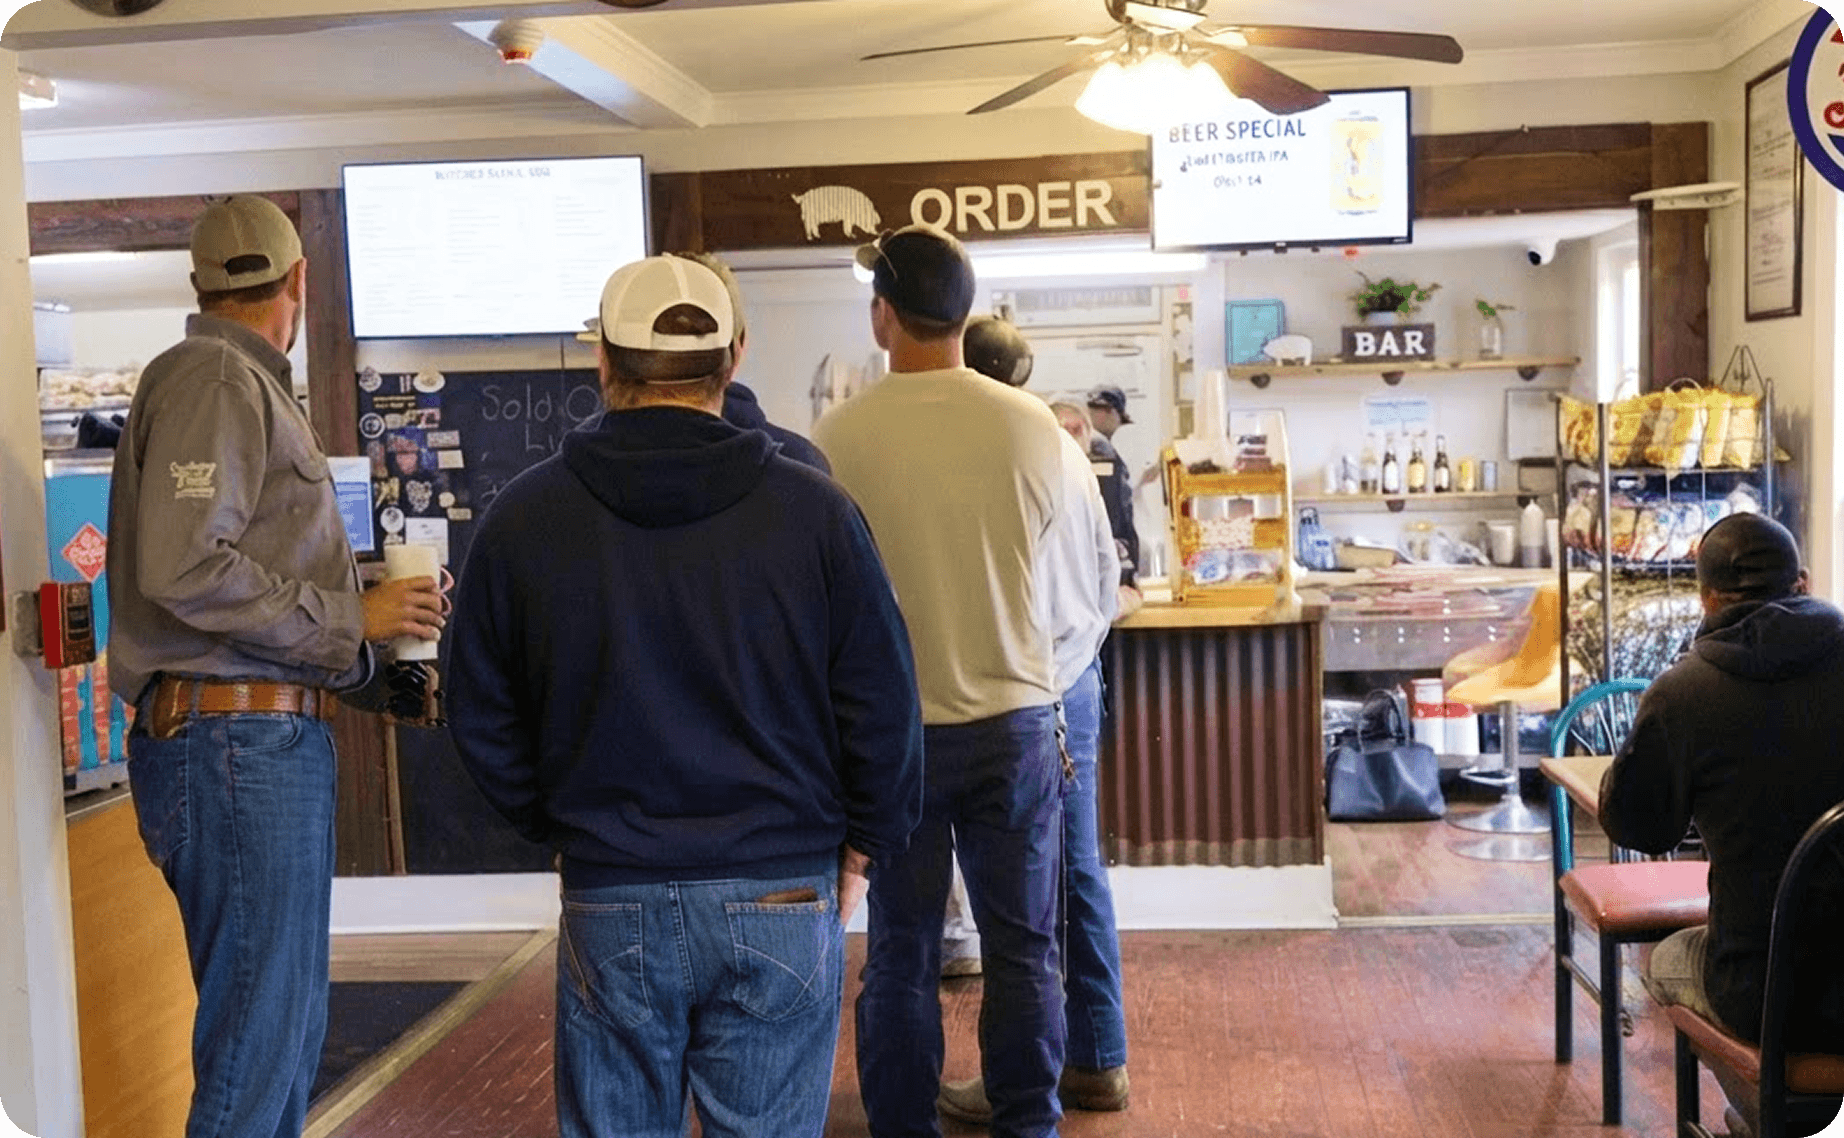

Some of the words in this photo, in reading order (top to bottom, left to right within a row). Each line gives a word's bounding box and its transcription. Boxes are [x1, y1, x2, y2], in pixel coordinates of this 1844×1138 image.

[1169, 122, 1219, 143] BEER
[1226, 119, 1307, 141] SPECIAL
[910, 179, 1118, 233] ORDER
[1354, 330, 1427, 357] BAR
[482, 383, 552, 422] Sold
